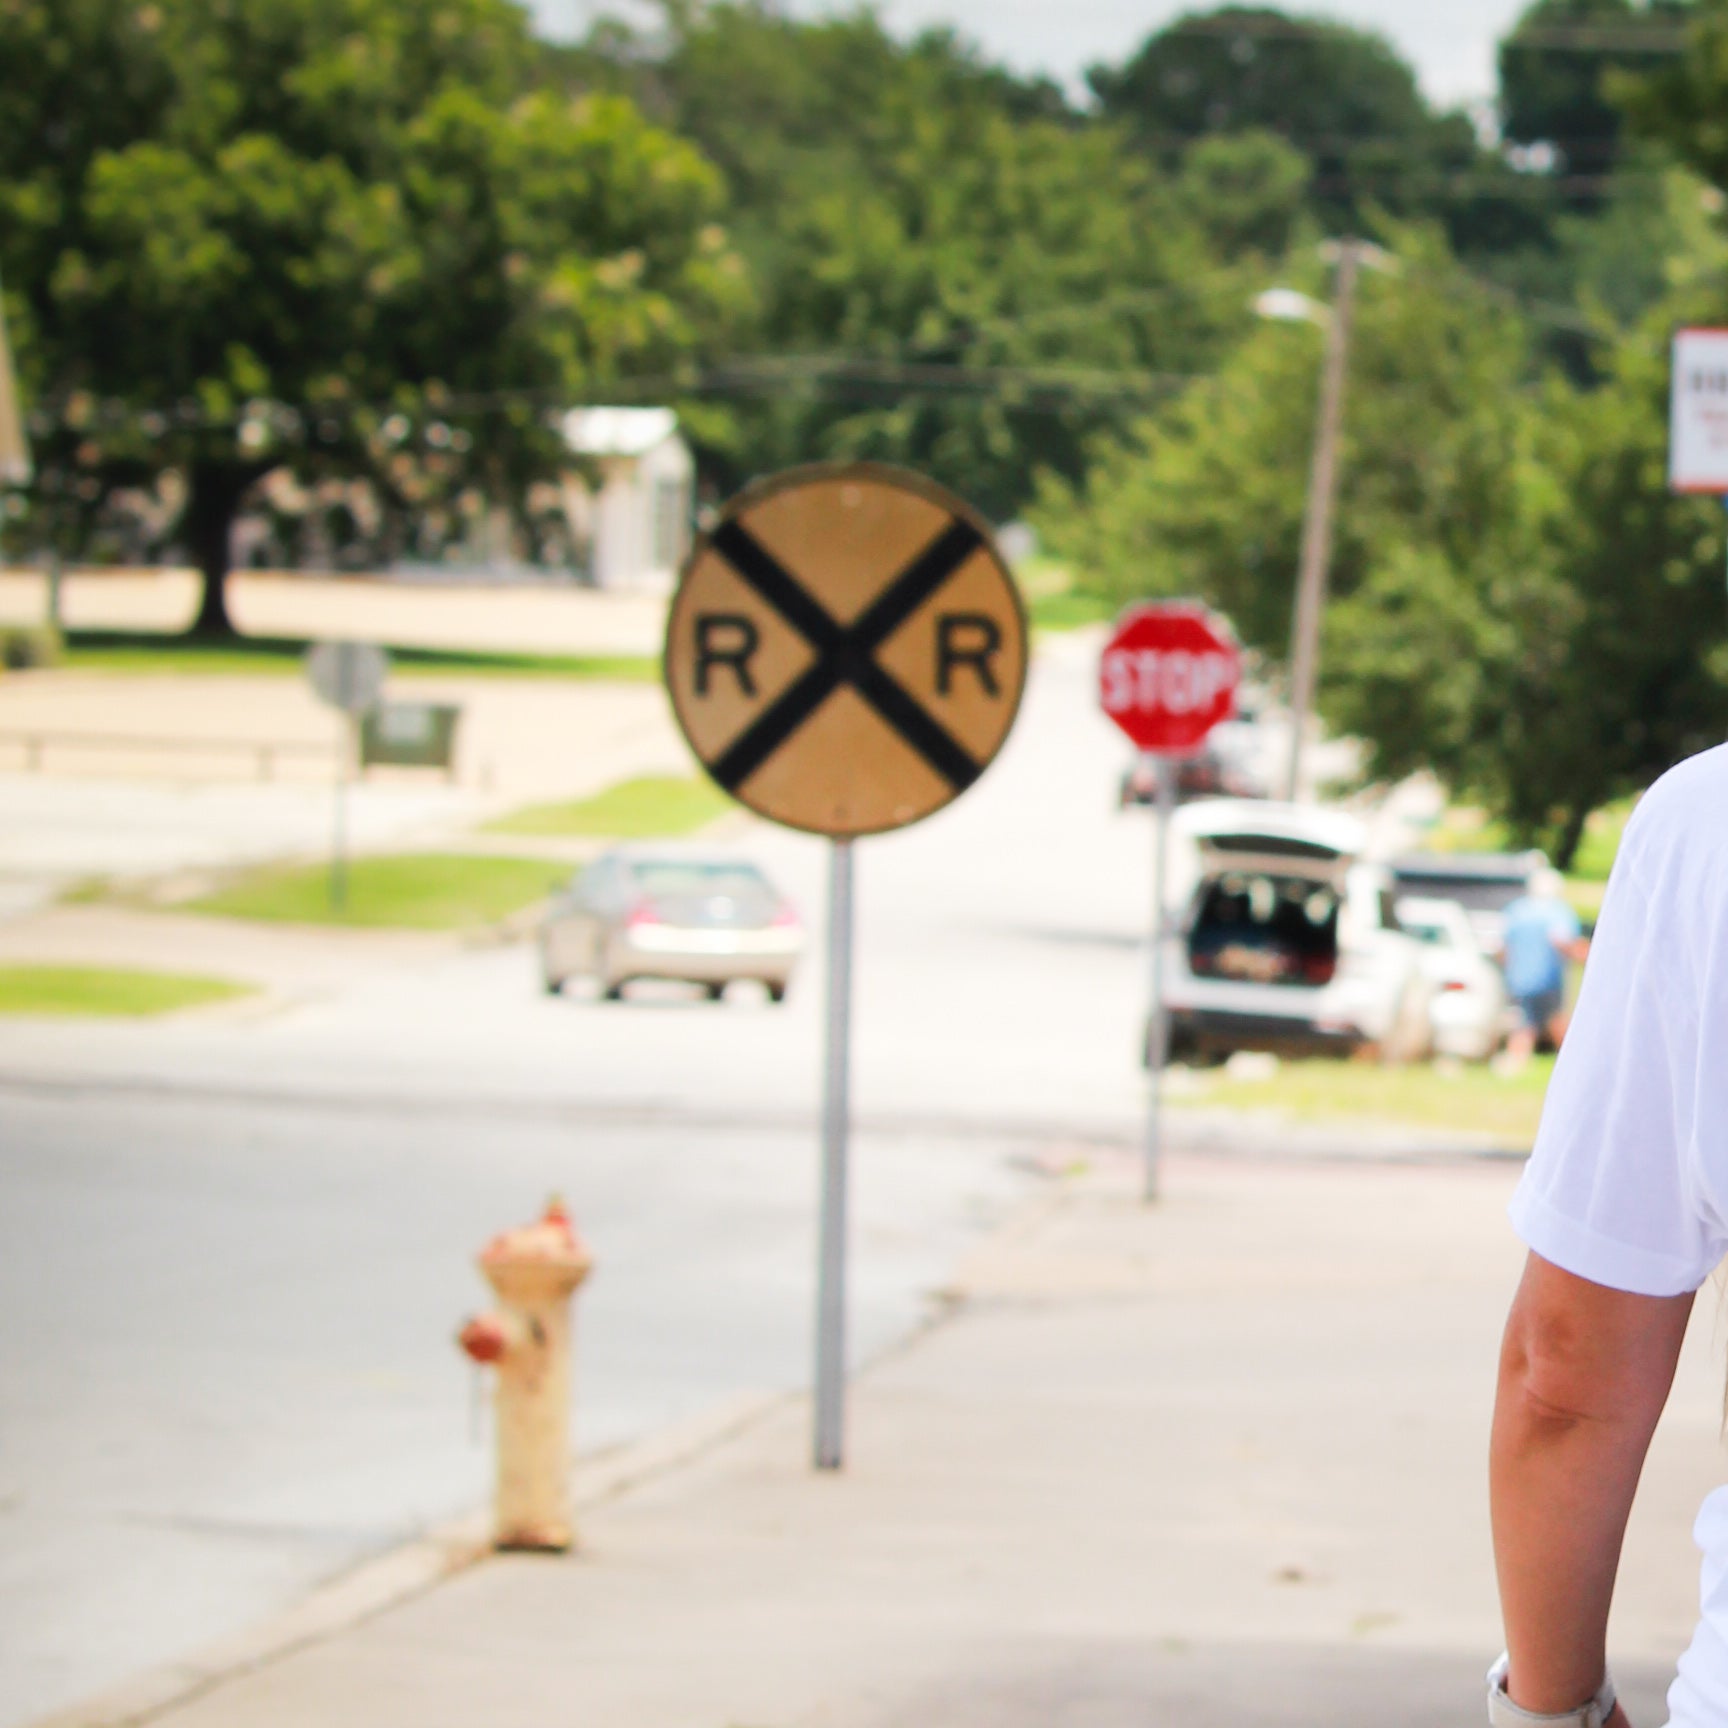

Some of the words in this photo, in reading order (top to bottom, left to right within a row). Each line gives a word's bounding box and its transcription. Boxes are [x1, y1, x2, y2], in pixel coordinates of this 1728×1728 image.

[693, 614, 757, 698] R
[935, 613, 1003, 698] R
[1102, 648, 1234, 714] STOP
